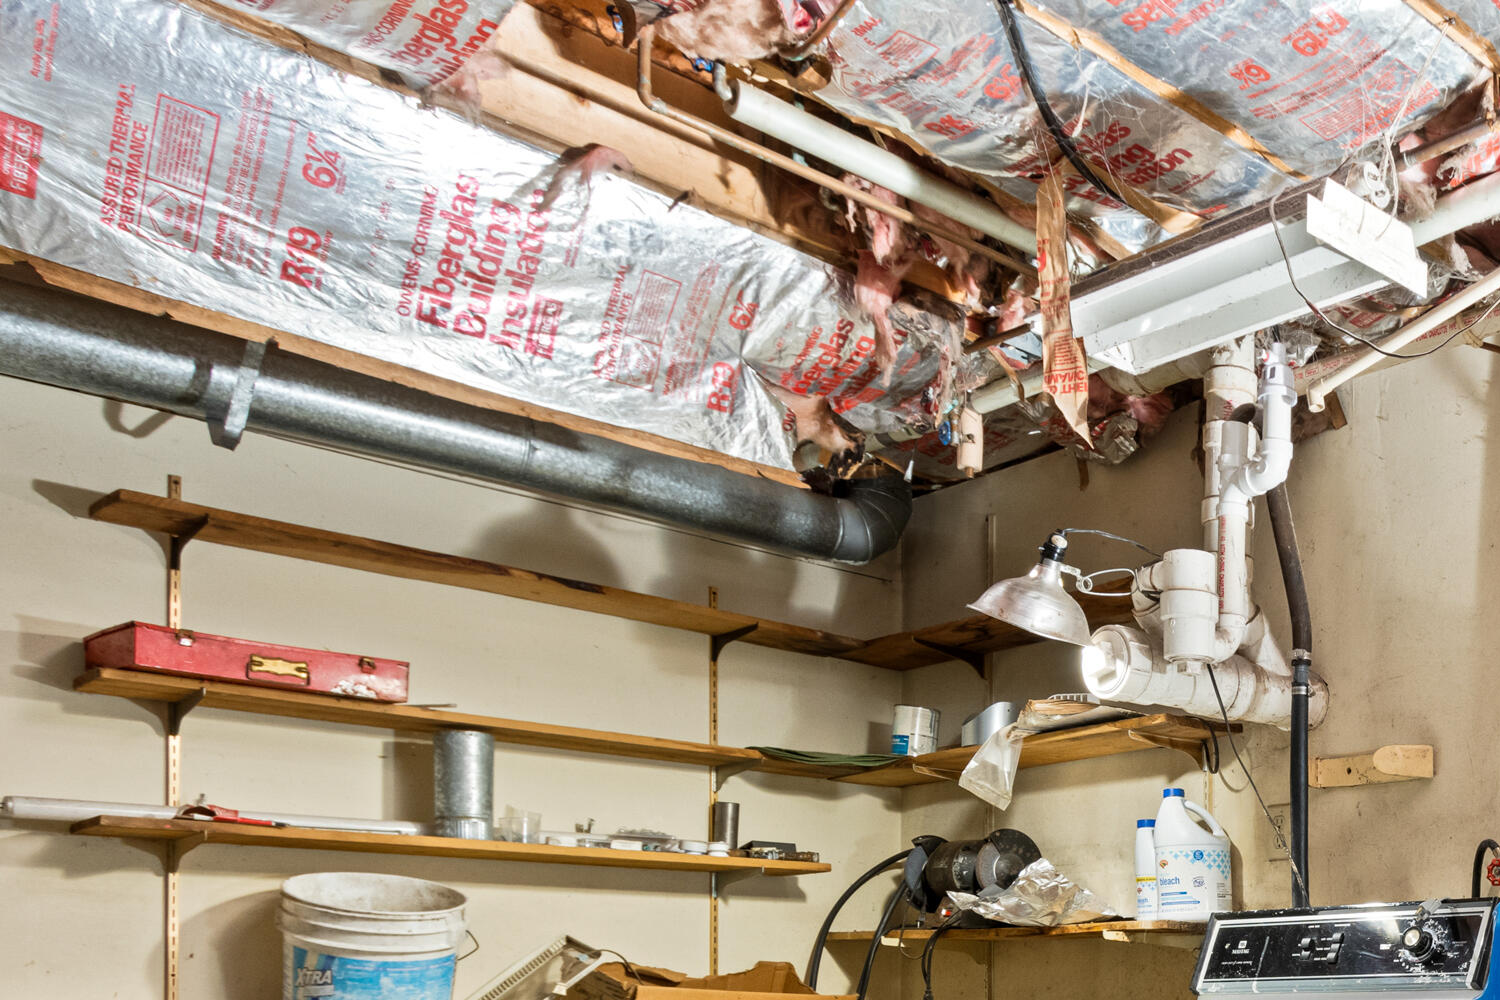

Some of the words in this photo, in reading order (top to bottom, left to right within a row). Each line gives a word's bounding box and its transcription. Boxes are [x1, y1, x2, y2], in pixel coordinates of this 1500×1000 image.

[109, 83, 136, 154] THERMAL
[9, 124, 33, 191] FIBERGLAS
[101, 156, 123, 228] ASSURED
[117, 120, 149, 234] PERFORMANCE
[280, 226, 323, 288] R-19
[414, 174, 480, 329] Fiberglas
[453, 198, 522, 340] Building
[604, 264, 632, 323] THERMAL
[1160, 876, 1180, 886] bleach
[295, 967, 333, 986] XTRA
